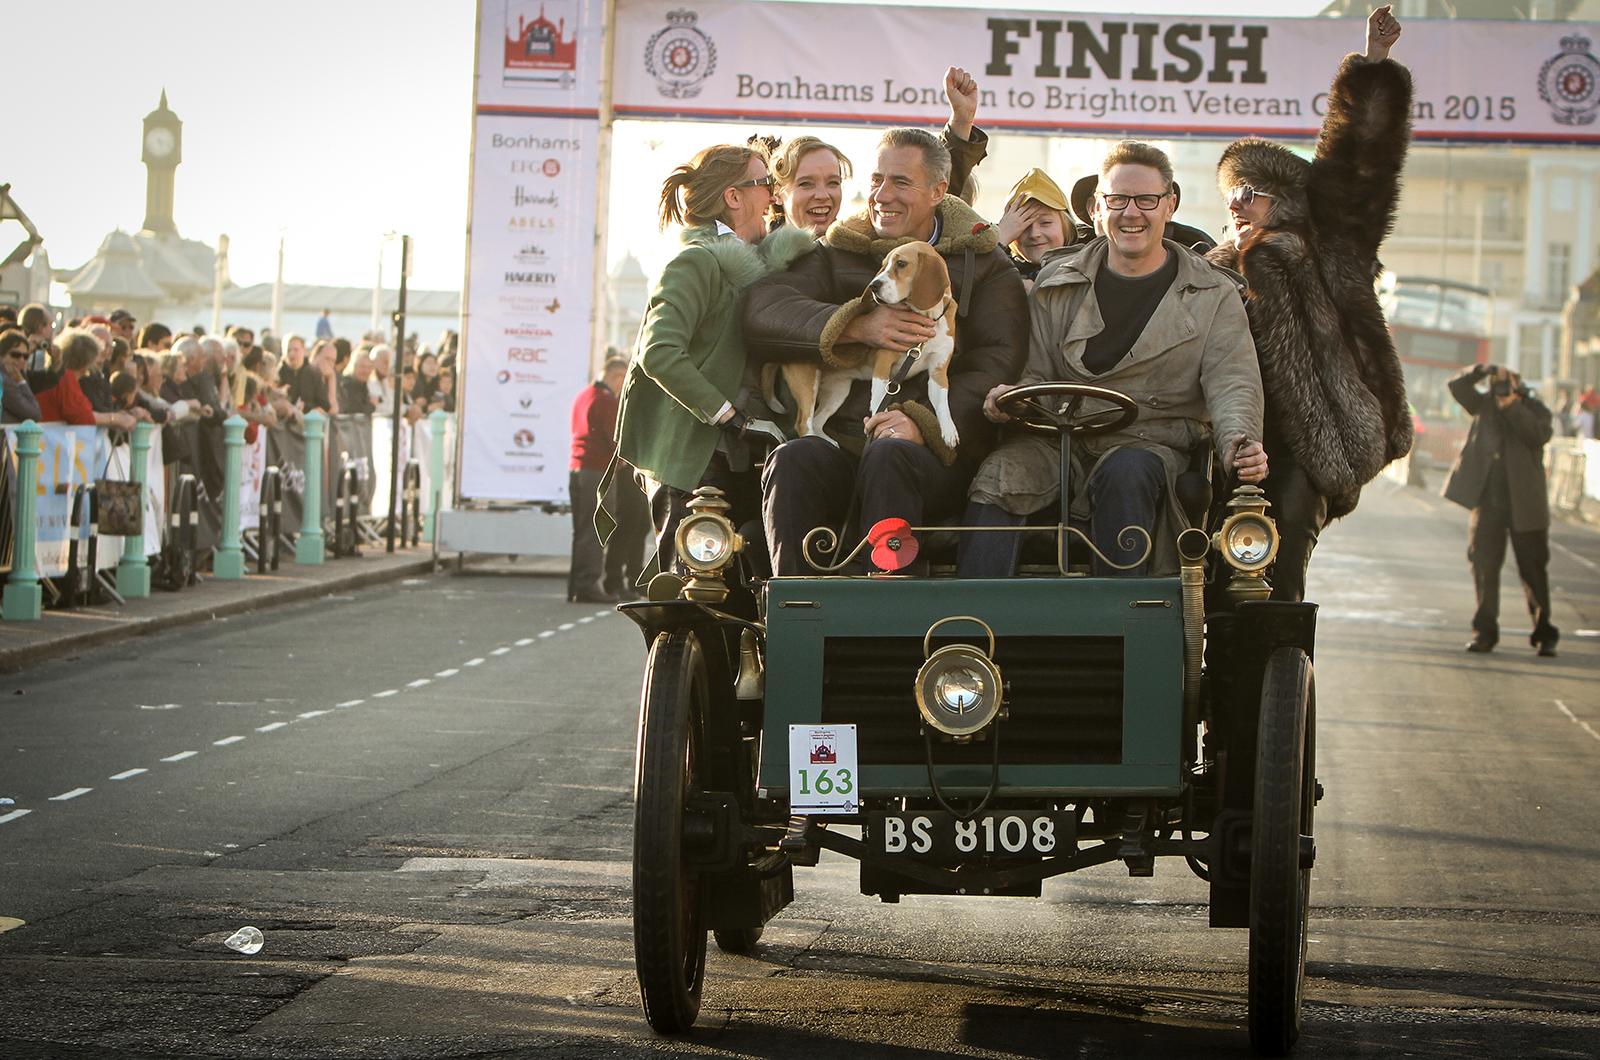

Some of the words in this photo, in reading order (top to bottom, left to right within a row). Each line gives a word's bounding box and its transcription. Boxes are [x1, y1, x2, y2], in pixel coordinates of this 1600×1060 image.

[986, 17, 1268, 84] FINISH
[736, 74, 874, 103] Bonhams
[883, 80, 998, 108] Lonn
[1008, 88, 1035, 109] to
[1045, 86, 1176, 118] Brighton
[1183, 90, 1302, 117] Veteran
[1444, 95, 1516, 121] 2015
[492, 133, 581, 151] Bonhams
[510, 160, 541, 174] EFG
[508, 216, 555, 229] ABELS
[504, 271, 557, 283] HAGERTY
[798, 768, 853, 795] 163
[884, 816, 933, 854] BS
[954, 816, 1056, 853] 8108
